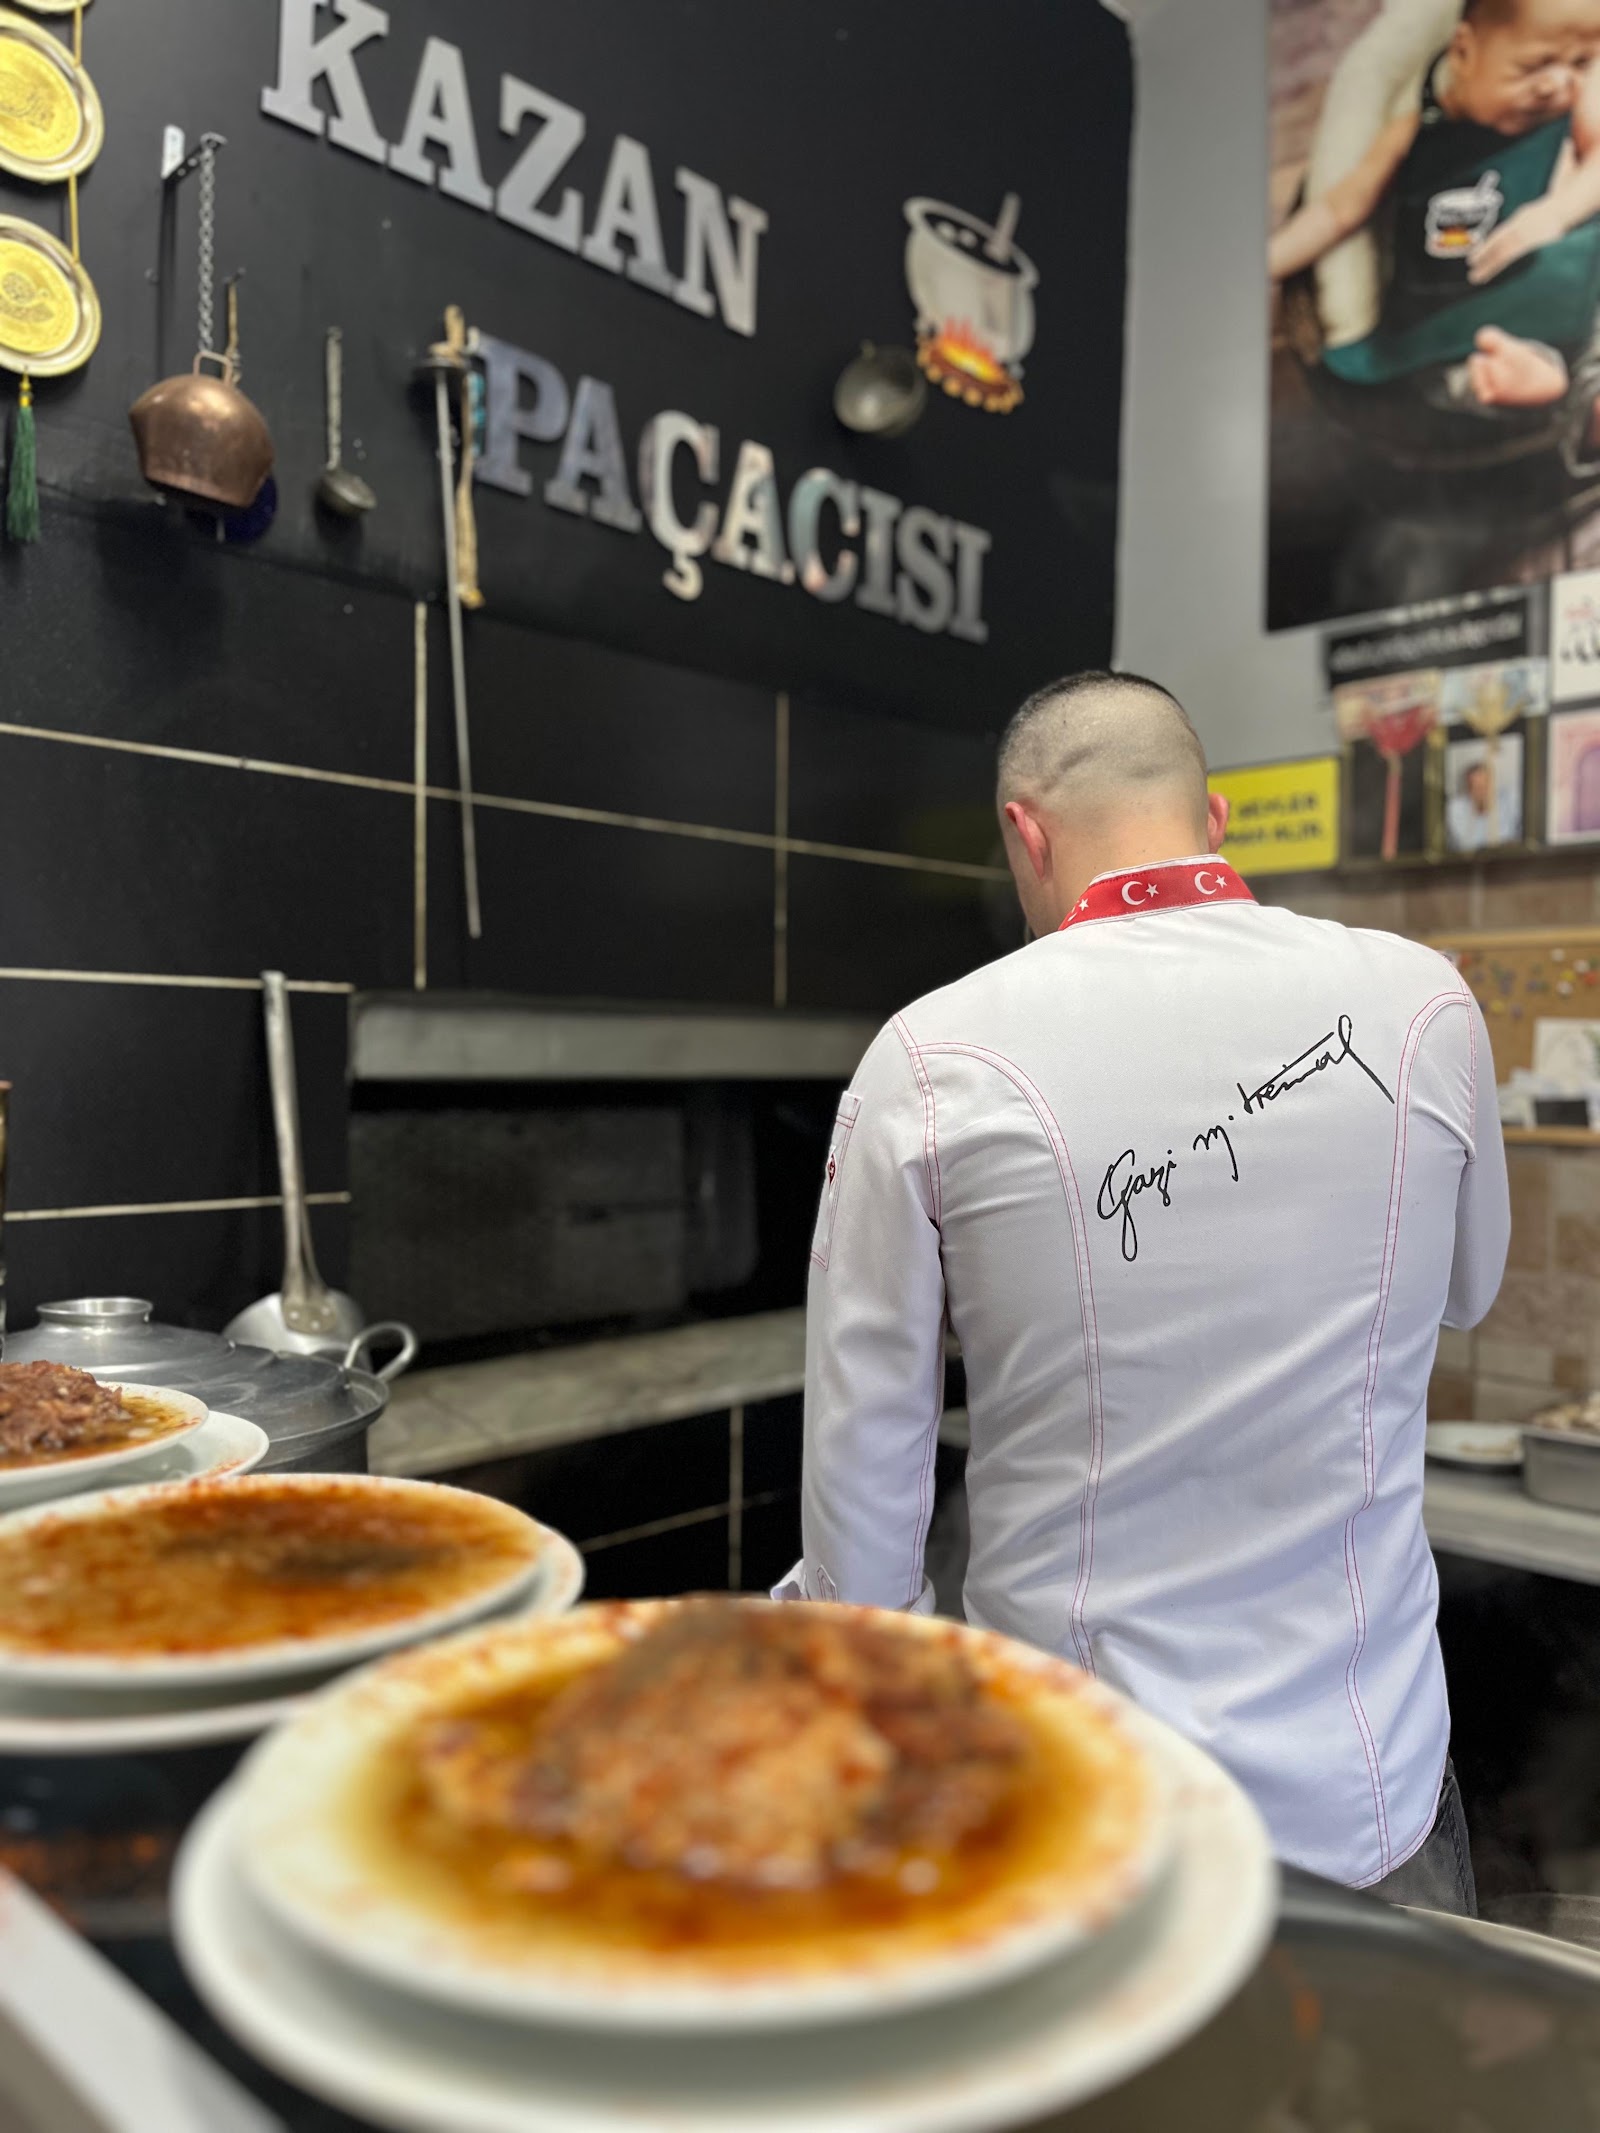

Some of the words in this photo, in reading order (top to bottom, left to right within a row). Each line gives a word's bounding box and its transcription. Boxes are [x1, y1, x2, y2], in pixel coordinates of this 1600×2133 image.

[261, 0, 769, 338] KAZAN
[472, 328, 993, 645] PAÇACISI
[1097, 1149, 1177, 1262] Gazi
